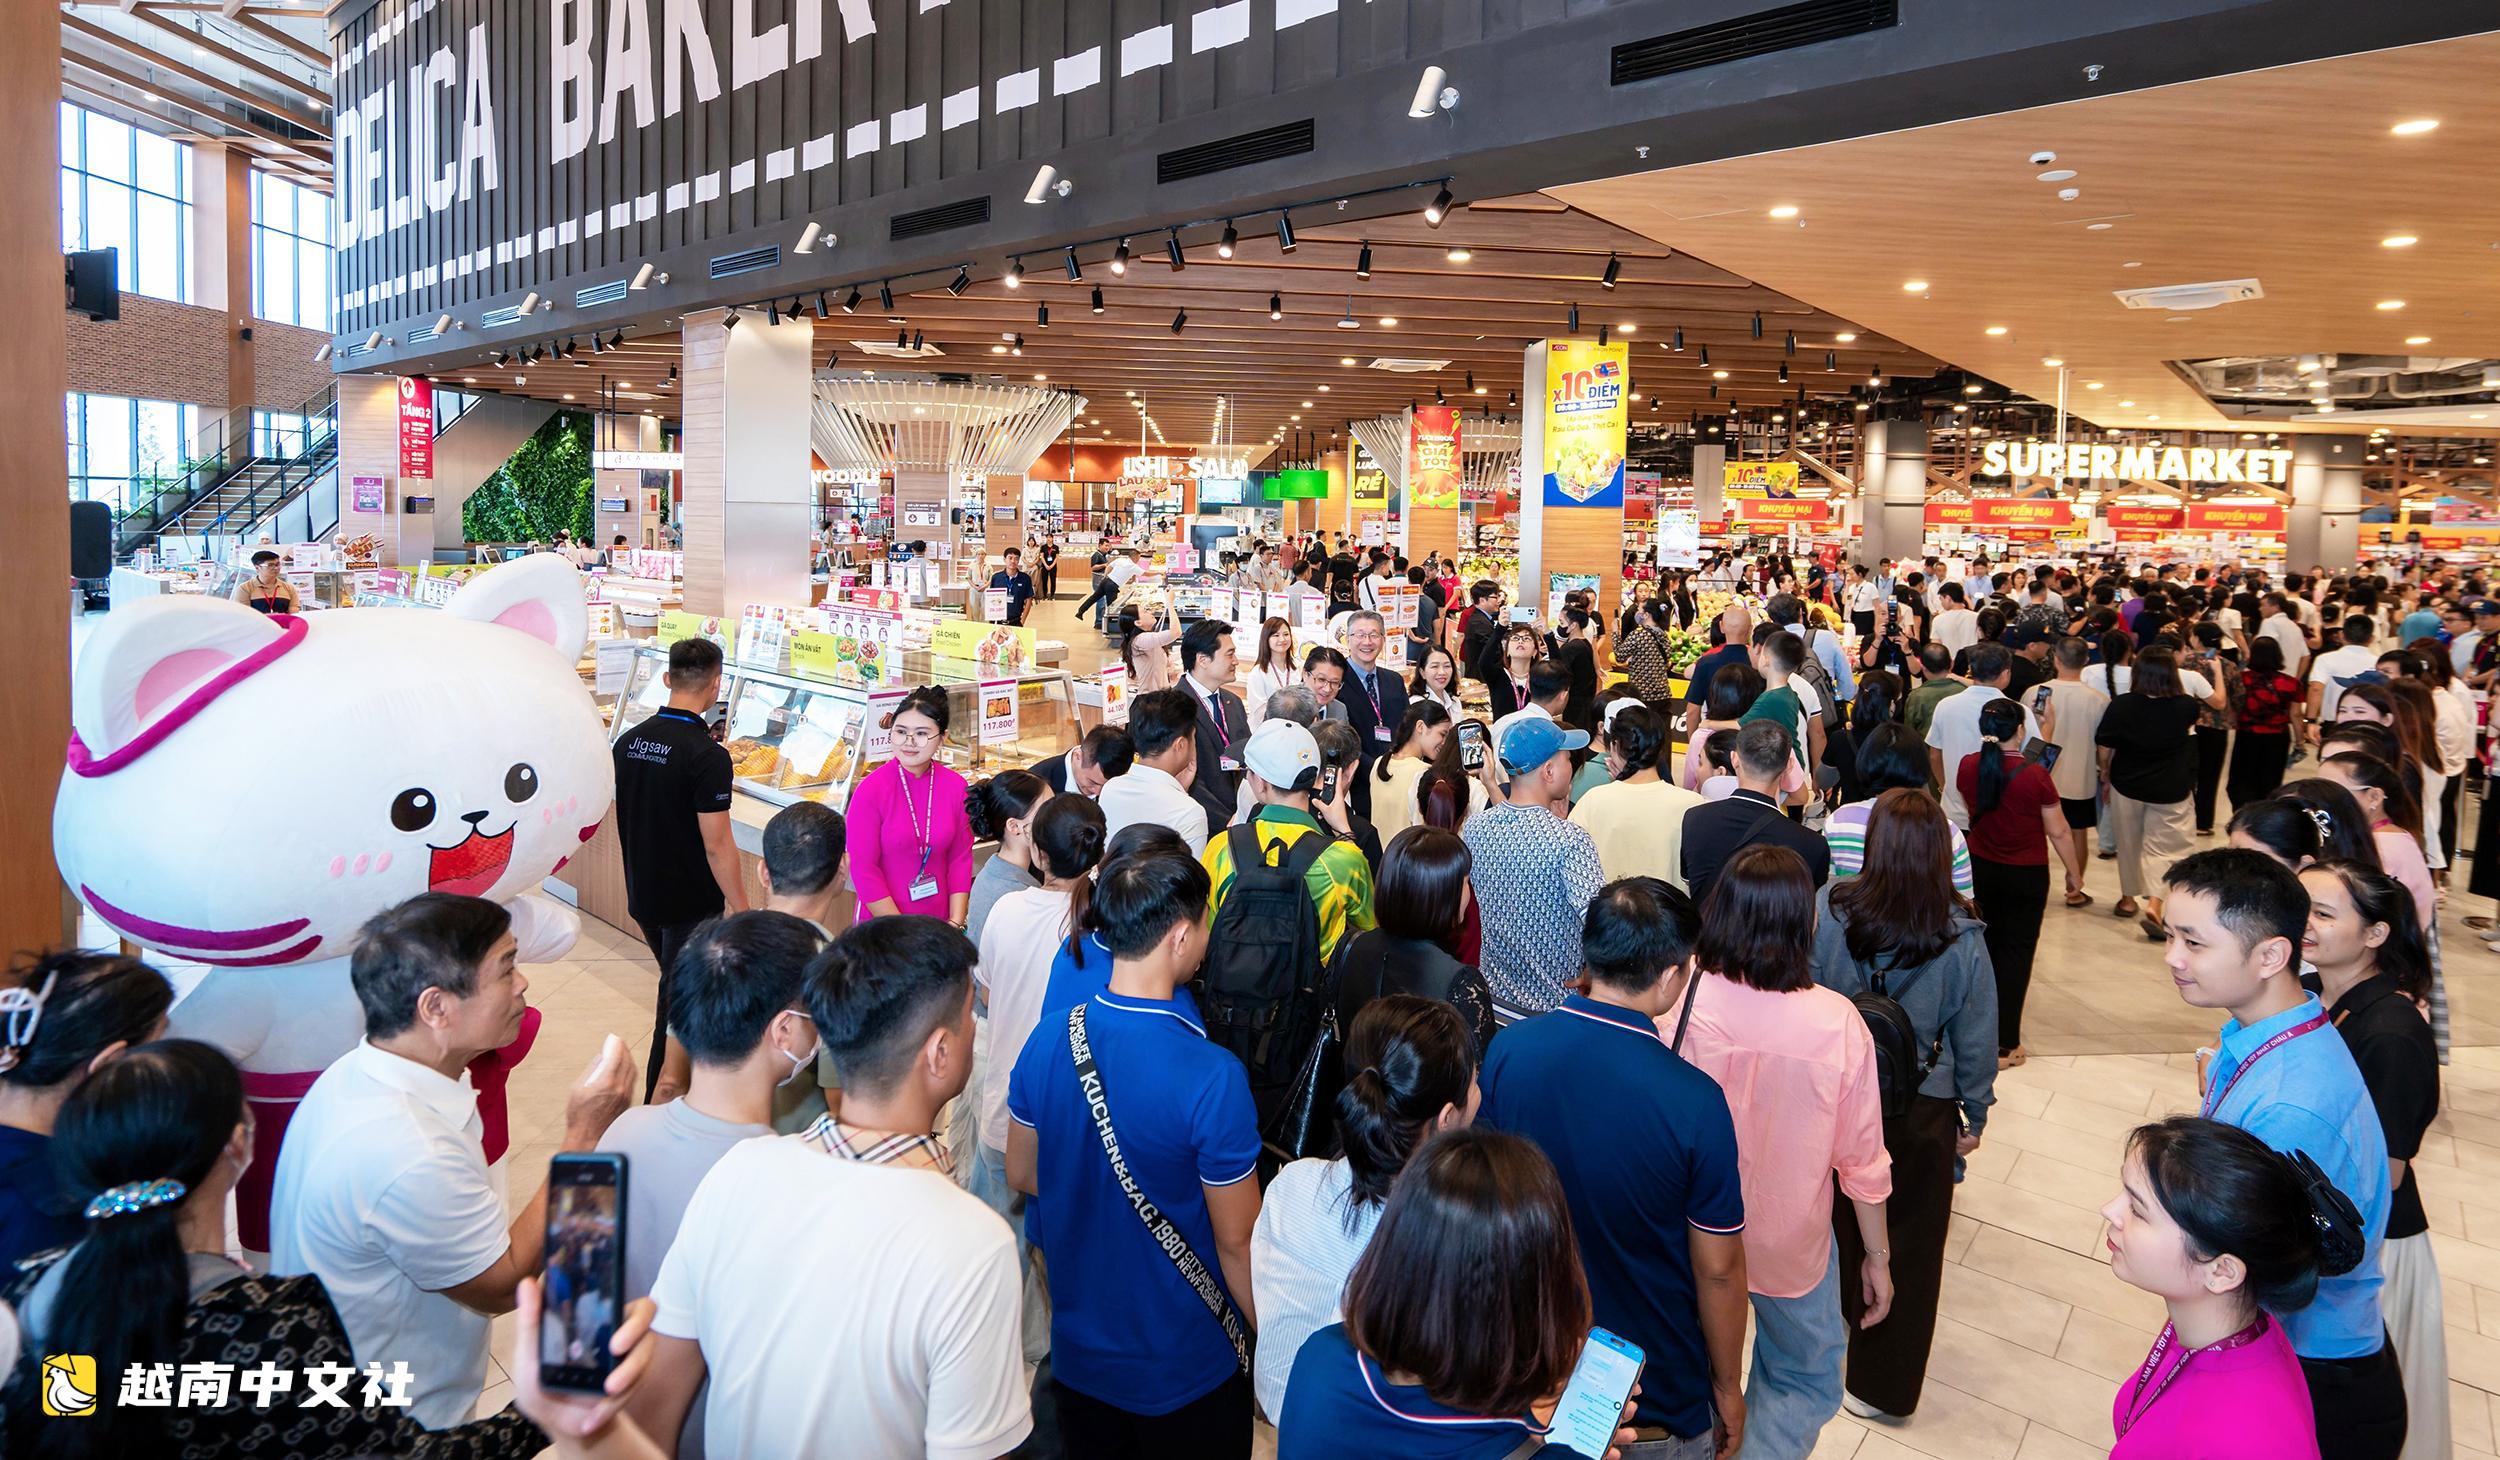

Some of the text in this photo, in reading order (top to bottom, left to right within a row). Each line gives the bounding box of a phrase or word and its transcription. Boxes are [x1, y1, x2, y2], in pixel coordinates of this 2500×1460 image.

[336, 21, 498, 252] DELICA
[425, 408, 432, 418] 2
[1980, 441, 2294, 483] SUPERMARKET
[628, 737, 673, 756] Jigsaw
[1176, 1257, 1222, 1316] NEWFASHION
[1185, 1250, 1225, 1303] CITYANDLIFE
